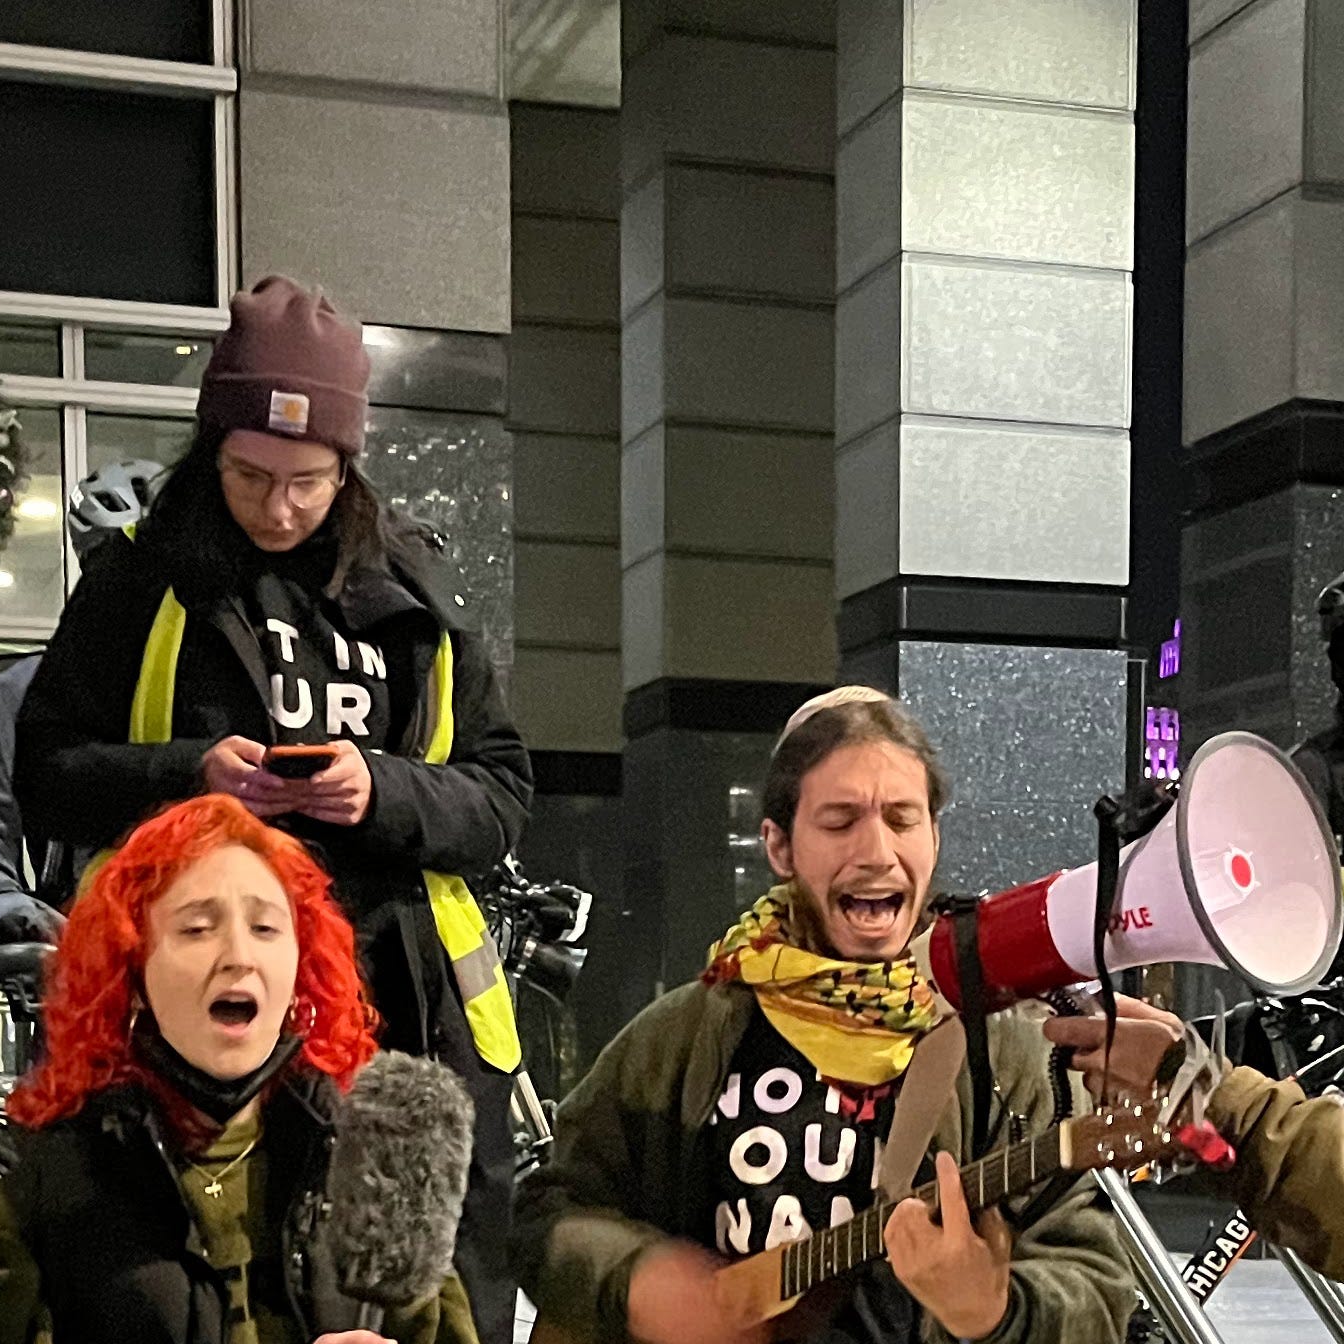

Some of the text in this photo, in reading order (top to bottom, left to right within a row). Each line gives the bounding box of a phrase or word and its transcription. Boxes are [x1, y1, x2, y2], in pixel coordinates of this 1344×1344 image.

[333, 631, 387, 680] IN
[270, 673, 373, 737] UR
[1182, 1208, 1251, 1297] HICAG
